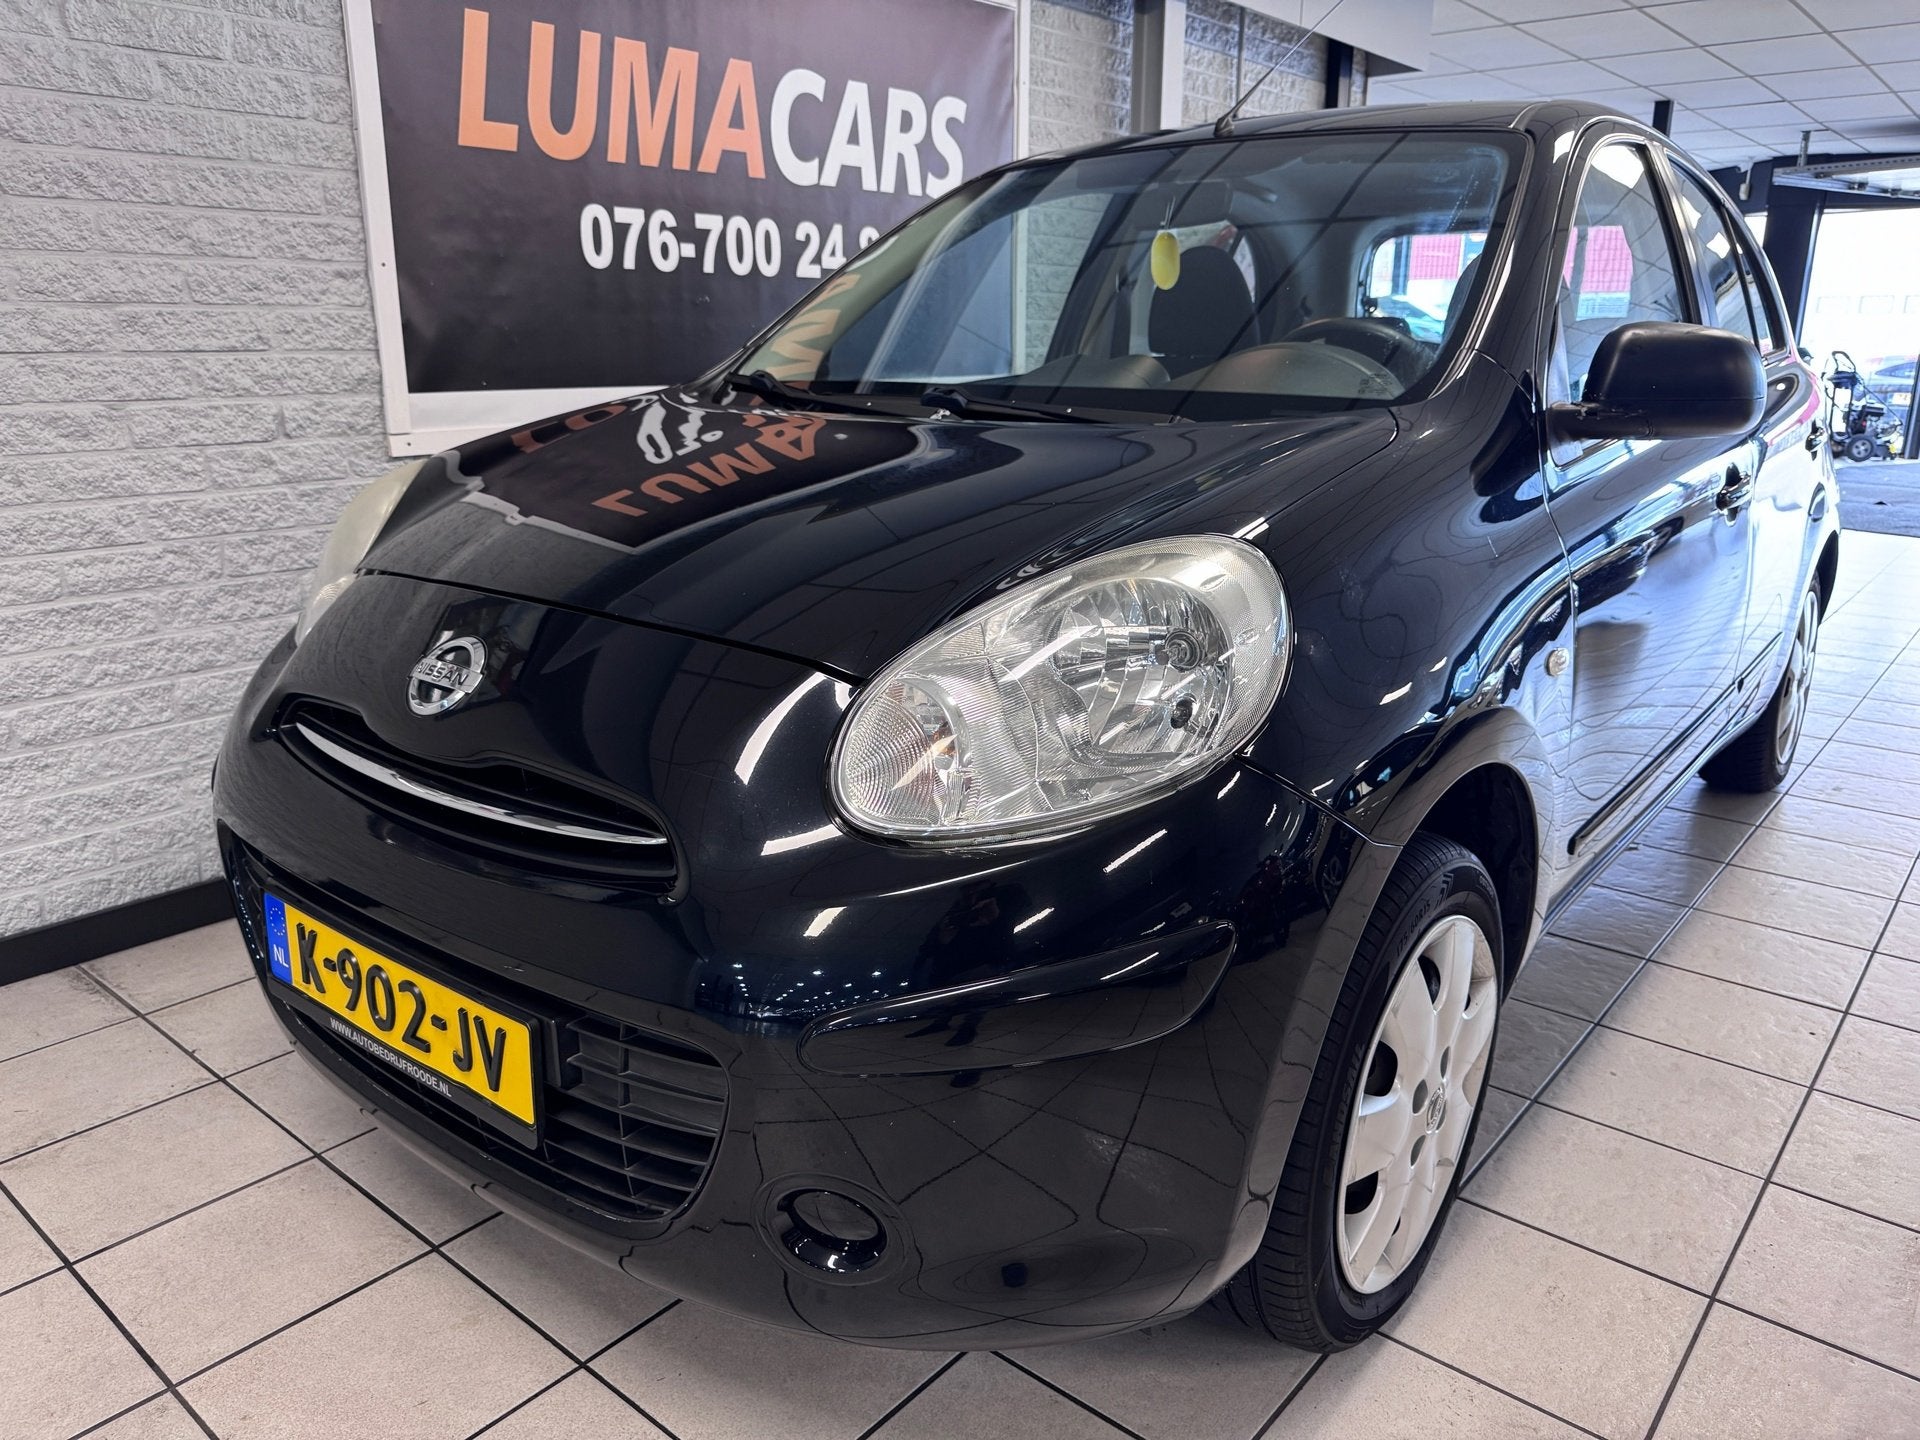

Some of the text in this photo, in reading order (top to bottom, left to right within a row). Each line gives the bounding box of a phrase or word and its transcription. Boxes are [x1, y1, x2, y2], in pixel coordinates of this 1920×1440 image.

[580, 203, 847, 279] 076-700 24
[416, 661, 470, 686] NISSAN
[273, 943, 290, 968] NL
[295, 922, 507, 1093] K-902-JV
[329, 1017, 453, 1098] WWW.AUTOBEDRIJFROODE.NL
